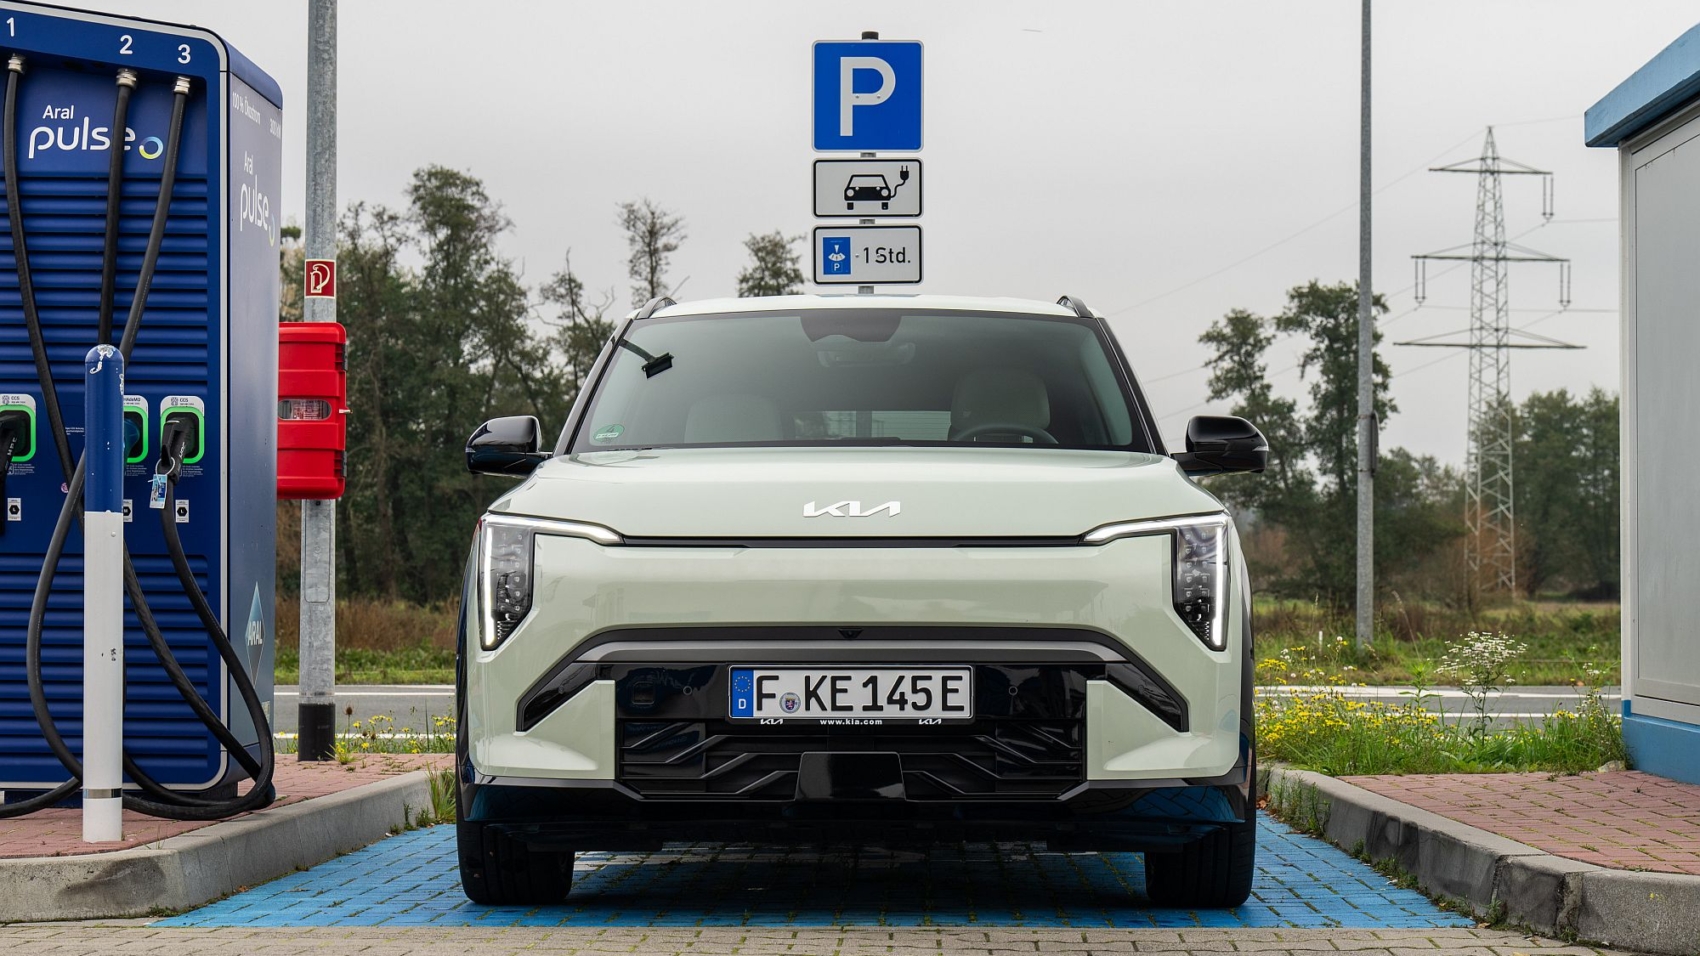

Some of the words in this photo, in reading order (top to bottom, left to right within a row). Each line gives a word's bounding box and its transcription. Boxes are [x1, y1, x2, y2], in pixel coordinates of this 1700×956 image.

[6, 17, 15, 37] 1
[119, 34, 133, 55] 2
[177, 44, 191, 64] 3
[840, 56, 896, 136] P
[42, 105, 75, 119] Aral
[28, 117, 136, 159] pulse
[243, 151, 254, 176] Aral
[240, 175, 269, 232] pulse
[863, 247, 869, 264] 1
[875, 247, 911, 264] Std.
[833, 263, 840, 271] P
[803, 500, 901, 518] KIA
[247, 620, 263, 646] ARAL
[756, 675, 780, 711] F
[738, 698, 747, 709] D
